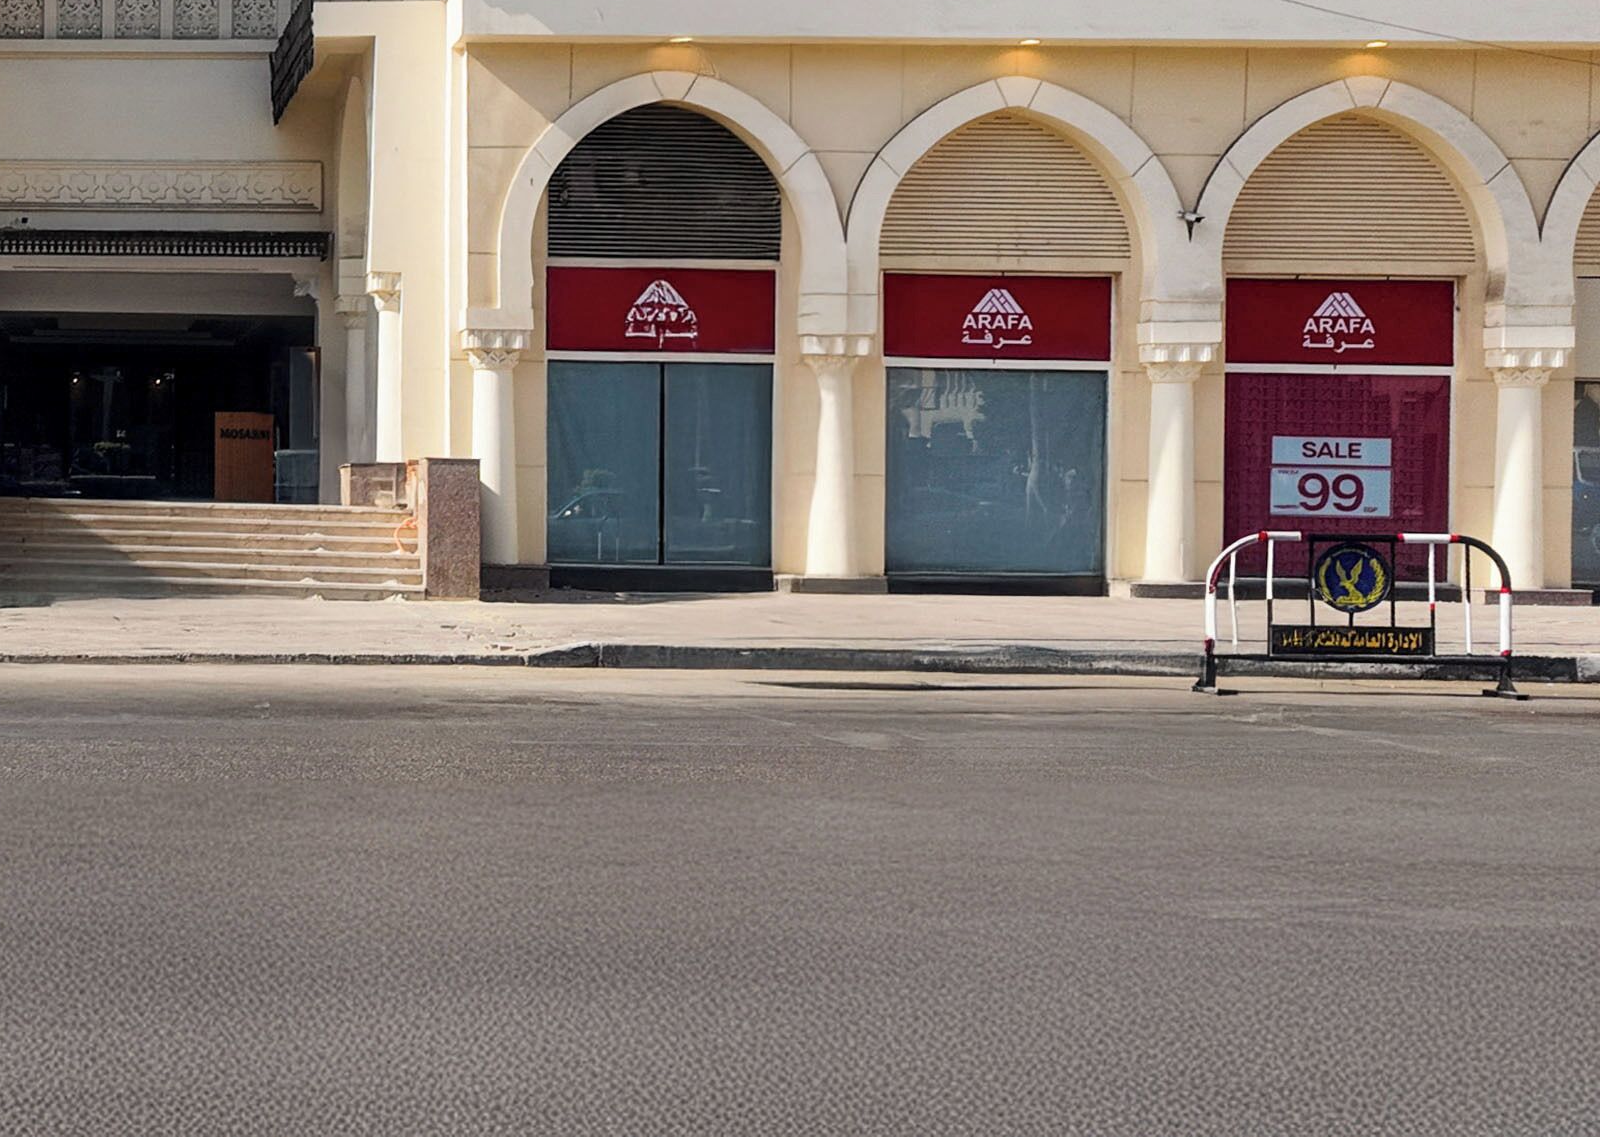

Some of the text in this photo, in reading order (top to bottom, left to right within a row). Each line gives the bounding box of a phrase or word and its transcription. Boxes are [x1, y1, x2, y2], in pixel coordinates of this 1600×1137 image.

[962, 313, 1033, 330] ARAFA
[1303, 317, 1376, 334] ARAFA
[961, 329, 1033, 349] عرفة
[1302, 333, 1375, 353] عرفة
[1302, 441, 1362, 459] SALE
[1297, 472, 1364, 512] 99
